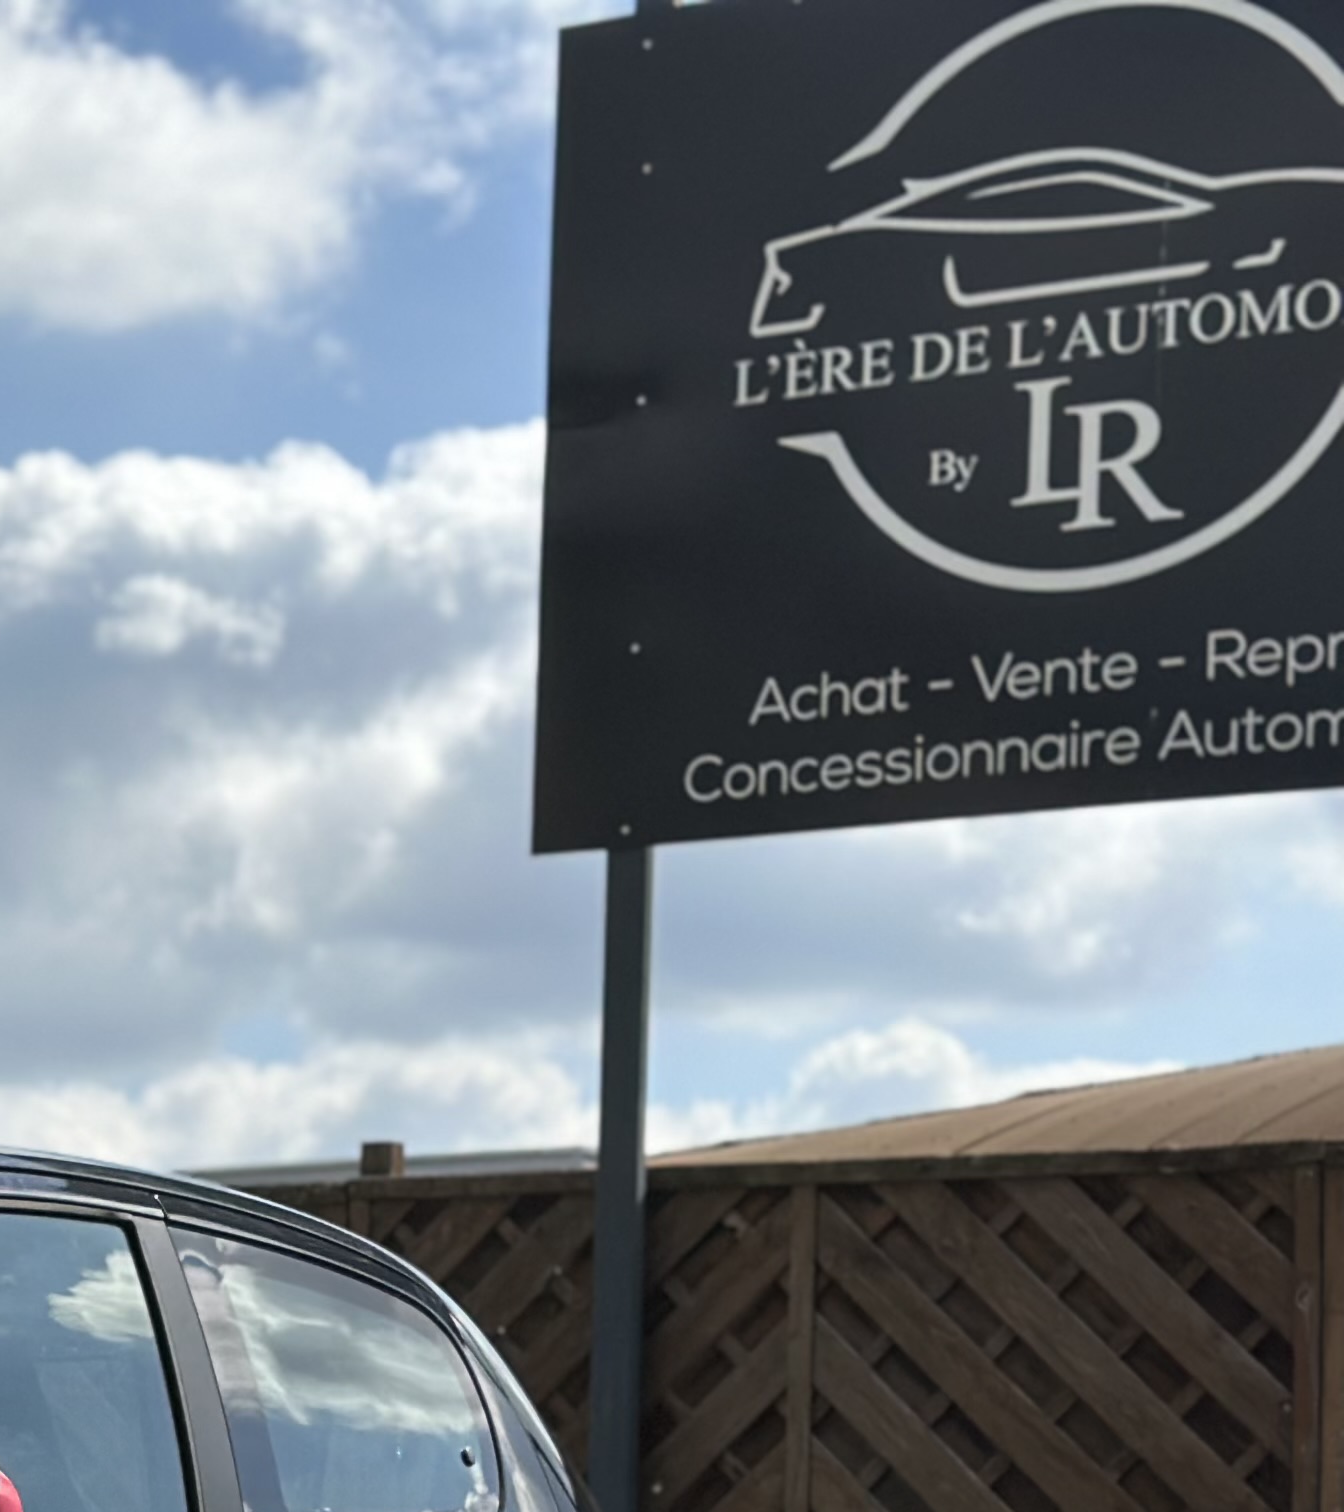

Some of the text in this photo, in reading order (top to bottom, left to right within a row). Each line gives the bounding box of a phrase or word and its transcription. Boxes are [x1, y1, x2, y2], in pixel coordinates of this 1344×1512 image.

[733, 338, 895, 408] L'ÈRE
[910, 326, 991, 385] DE
[928, 376, 1183, 532] By LR
[748, 666, 910, 726] Achat
[971, 646, 1139, 703] Vente
[684, 721, 1141, 803] Concessionnaire
